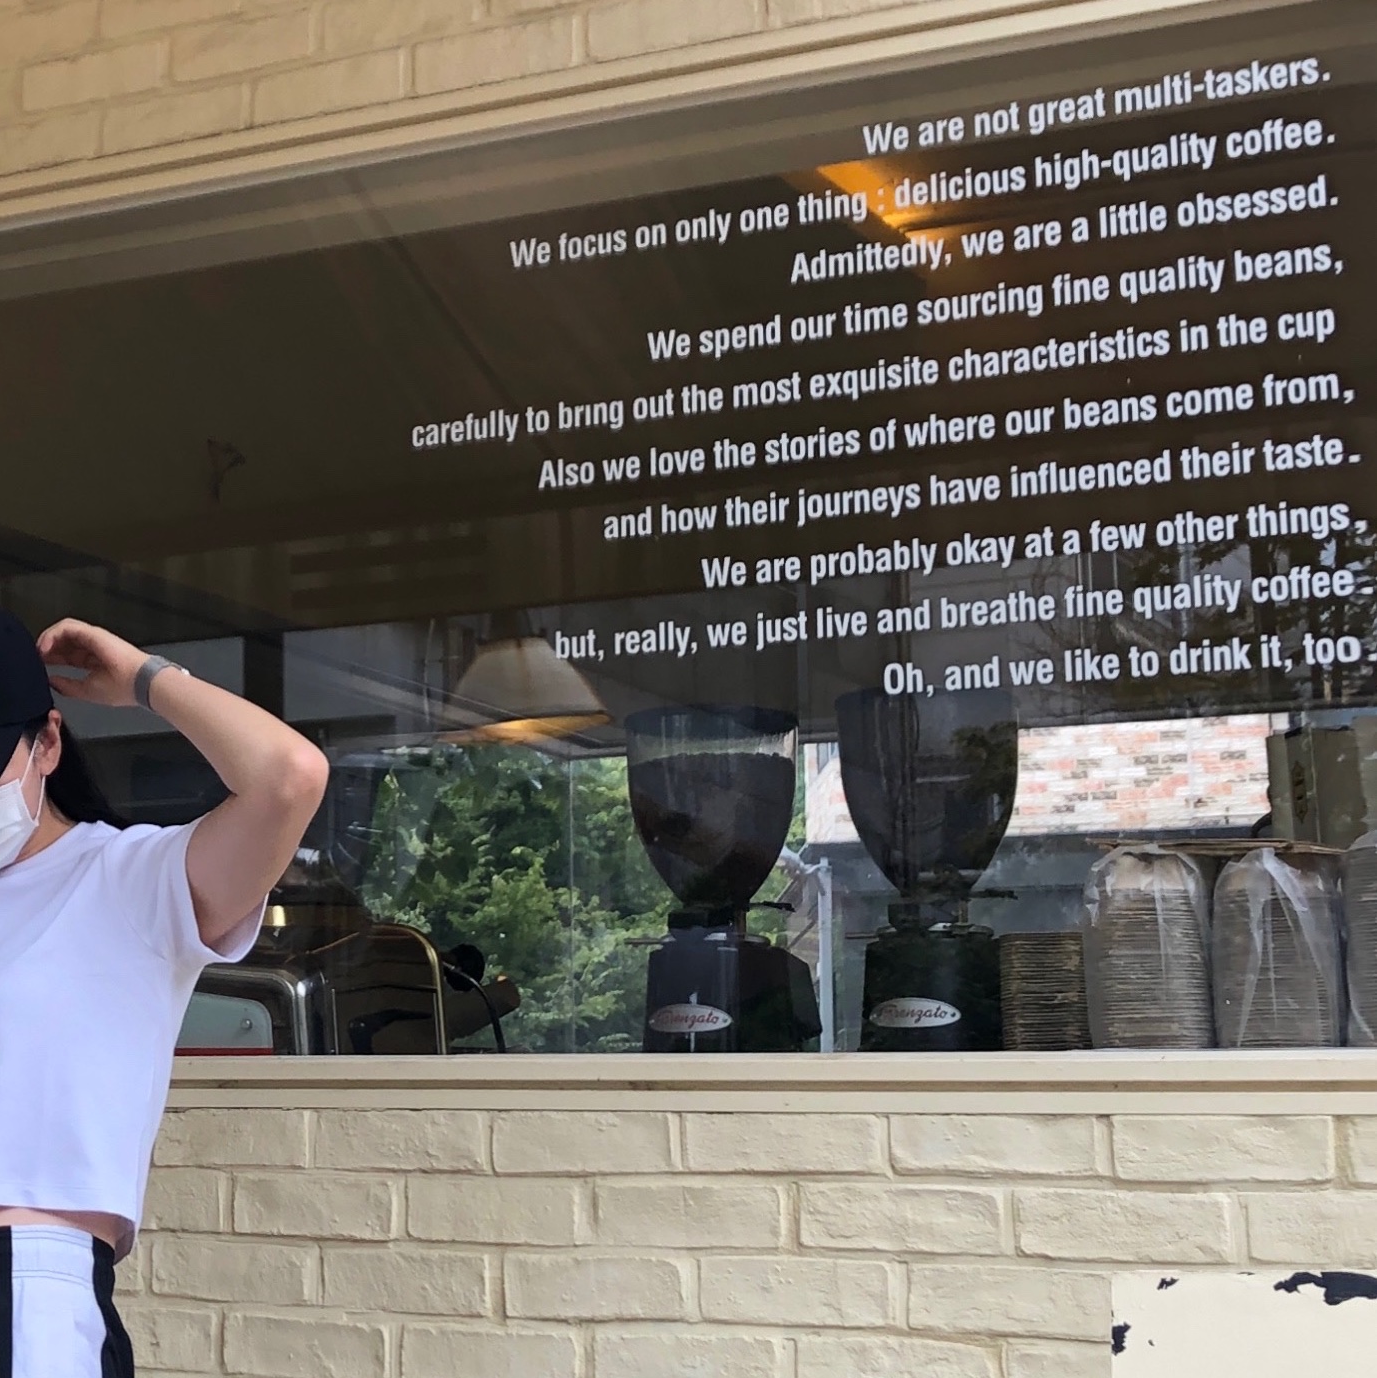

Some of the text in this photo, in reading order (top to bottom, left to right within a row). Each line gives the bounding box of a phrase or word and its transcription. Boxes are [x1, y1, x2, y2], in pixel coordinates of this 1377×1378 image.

[862, 57, 1331, 155] We are not great multi-taskers.
[509, 237, 551, 268] We
[558, 229, 627, 261] focus
[635, 223, 667, 249] on
[675, 208, 732, 243] only
[739, 203, 790, 233] one
[797, 189, 868, 225] thing
[893, 165, 1027, 205] delicious
[1034, 132, 1217, 190] high-quality
[1226, 117, 1335, 158] coffee.
[790, 174, 1339, 284] Admittedly, we are a little obsessed.
[647, 244, 1343, 360] We spend our time sourcing fine quality beans,
[412, 308, 1335, 448] carefully to bring out the most exquisite characteristics in the cup
[538, 373, 1354, 489] Also we love the stories of where our beans come from,
[603, 434, 1361, 539] and how their journeys have influenced their taste.
[701, 501, 1368, 588] We are probably okay at a few other things,
[555, 561, 1374, 661] but, really, we just live and breathe fine quality coffee.
[883, 632, 1377, 697] Oh, and we like to drink it, too.
